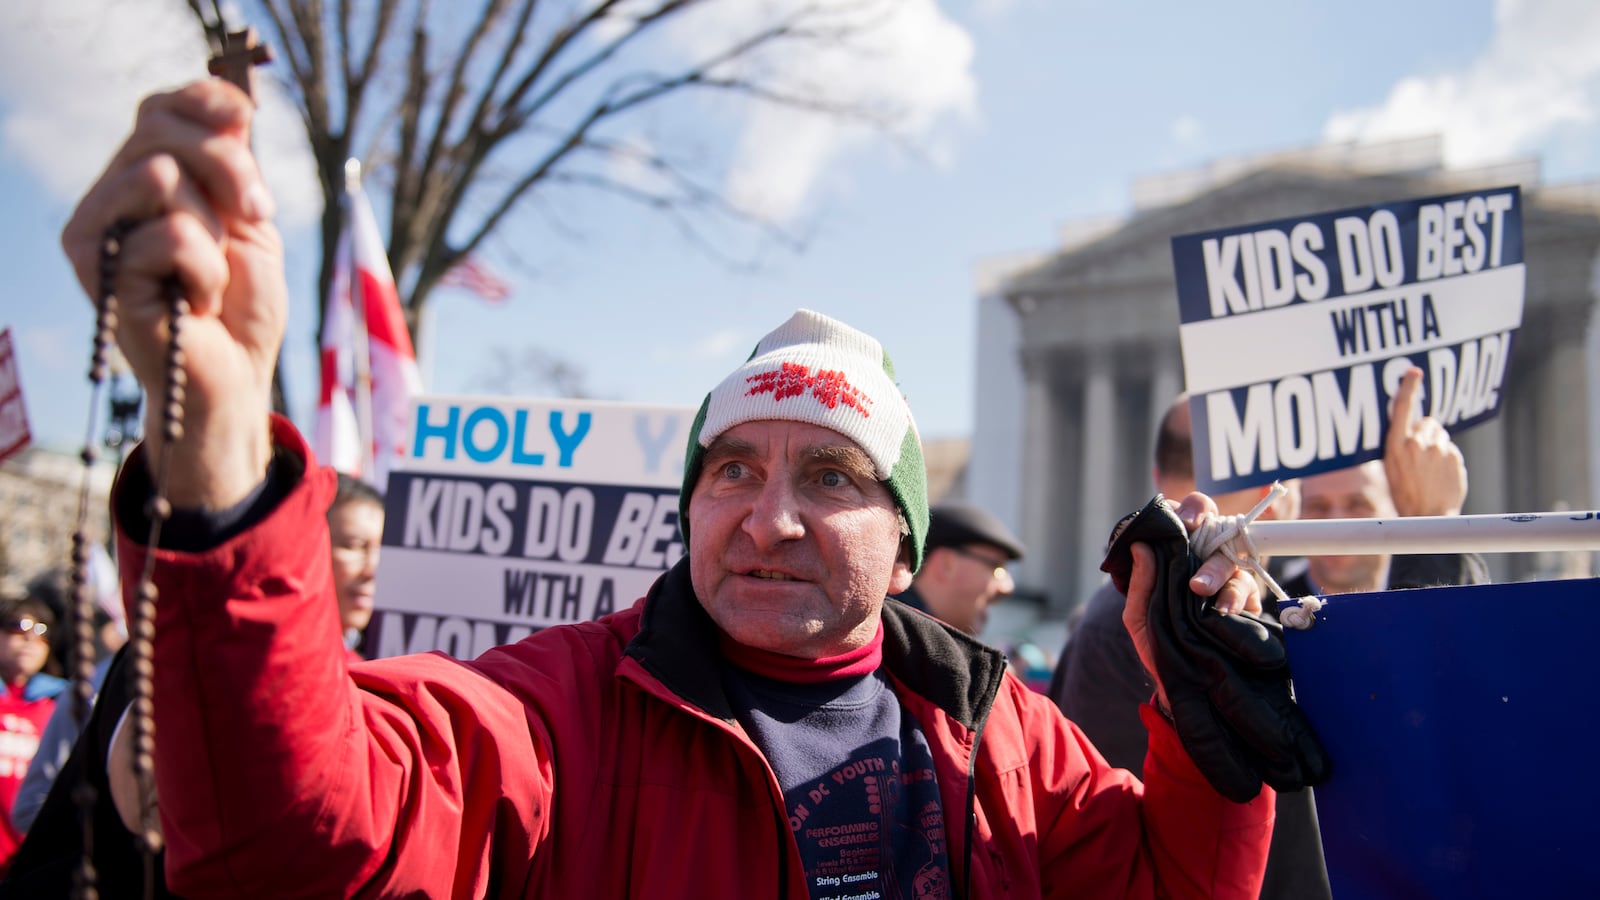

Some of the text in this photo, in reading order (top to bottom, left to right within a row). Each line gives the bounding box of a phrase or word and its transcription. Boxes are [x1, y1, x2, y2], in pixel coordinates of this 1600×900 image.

[1202, 194, 1513, 317] KIDS DO BEST
[1330, 293, 1441, 357] WITH A
[1206, 363, 1382, 481] MOM
[1428, 331, 1511, 425] DAD!
[413, 405, 592, 467] HOLY
[403, 478, 687, 570] KIDS DO BE
[504, 568, 615, 621] WITH A
[808, 783, 831, 804] DC
[832, 757, 886, 785] YOUTH
[806, 822, 879, 839] PERFORMING
[818, 833, 880, 847] ENSEMBLES
[816, 870, 879, 886] String Ensemble
